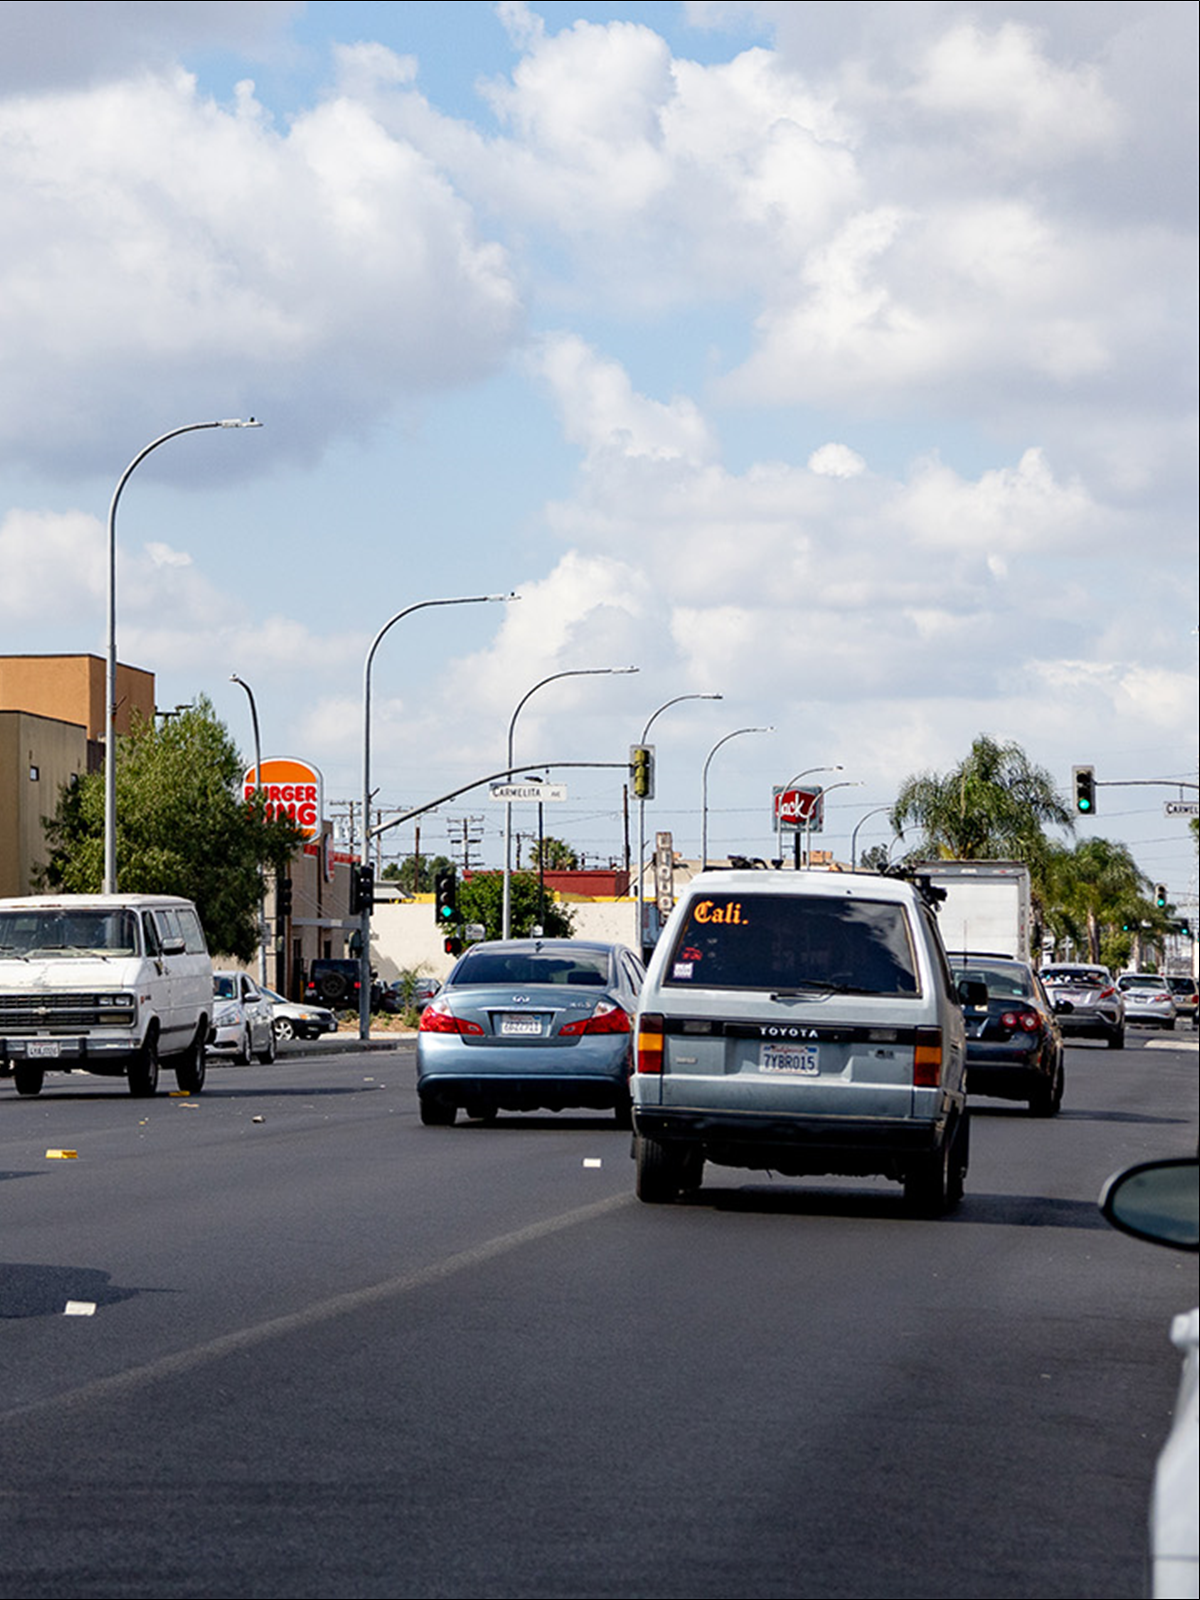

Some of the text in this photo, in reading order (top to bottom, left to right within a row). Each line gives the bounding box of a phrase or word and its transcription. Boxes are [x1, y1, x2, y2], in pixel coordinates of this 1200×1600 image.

[244, 785, 318, 802] BRGER
[247, 802, 318, 826] ING
[694, 900, 749, 925] Cali.
[760, 1027, 819, 1039] TOYOTA
[763, 1053, 816, 1070] 7YBR015
